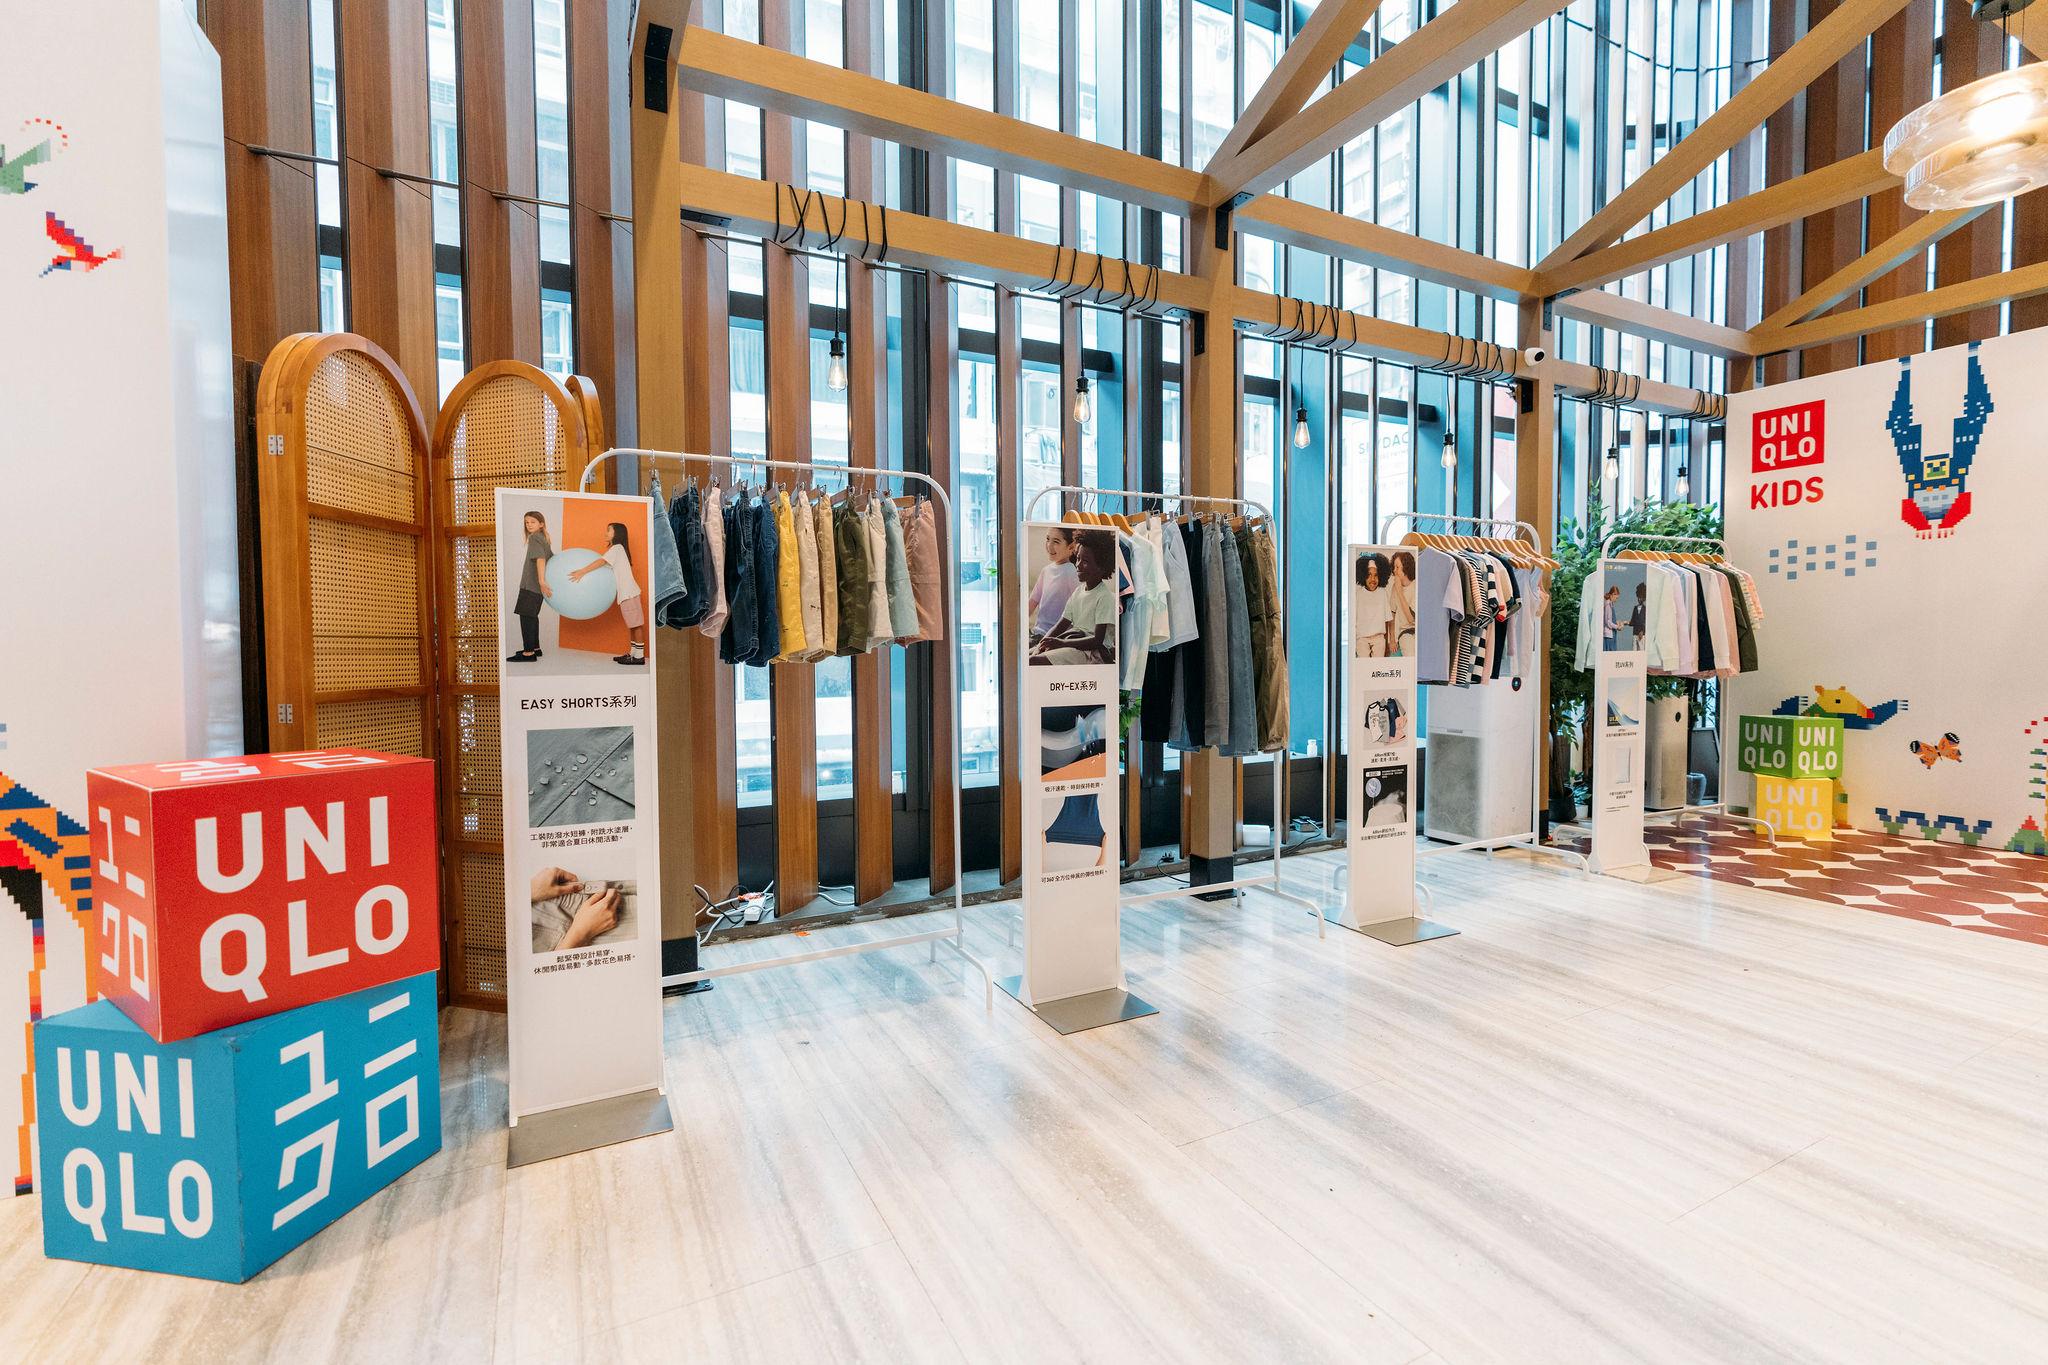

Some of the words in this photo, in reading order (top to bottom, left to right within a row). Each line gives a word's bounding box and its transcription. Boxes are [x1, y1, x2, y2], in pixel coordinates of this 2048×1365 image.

[1760, 410, 1811, 439] UNI
[1760, 436, 1816, 467] QLO
[1751, 476, 1824, 510] KIDS
[1050, 680, 1098, 691] DRY-EX系列
[521, 698, 554, 710] EASY
[561, 695, 637, 709] SHORTS系列
[1745, 723, 1783, 745] UNI
[1798, 726, 1835, 747] UNI
[1744, 746, 1786, 769] QLO
[1798, 750, 1838, 774] QLO
[1765, 783, 1818, 807] UNI
[1765, 808, 1823, 832] QLO
[195, 796, 390, 894] UNI
[200, 884, 409, 1003] QLO
[274, 991, 418, 1126] ユニ
[56, 1047, 196, 1139] UNI
[272, 1075, 420, 1231] クロ
[63, 1147, 214, 1242] QLO
